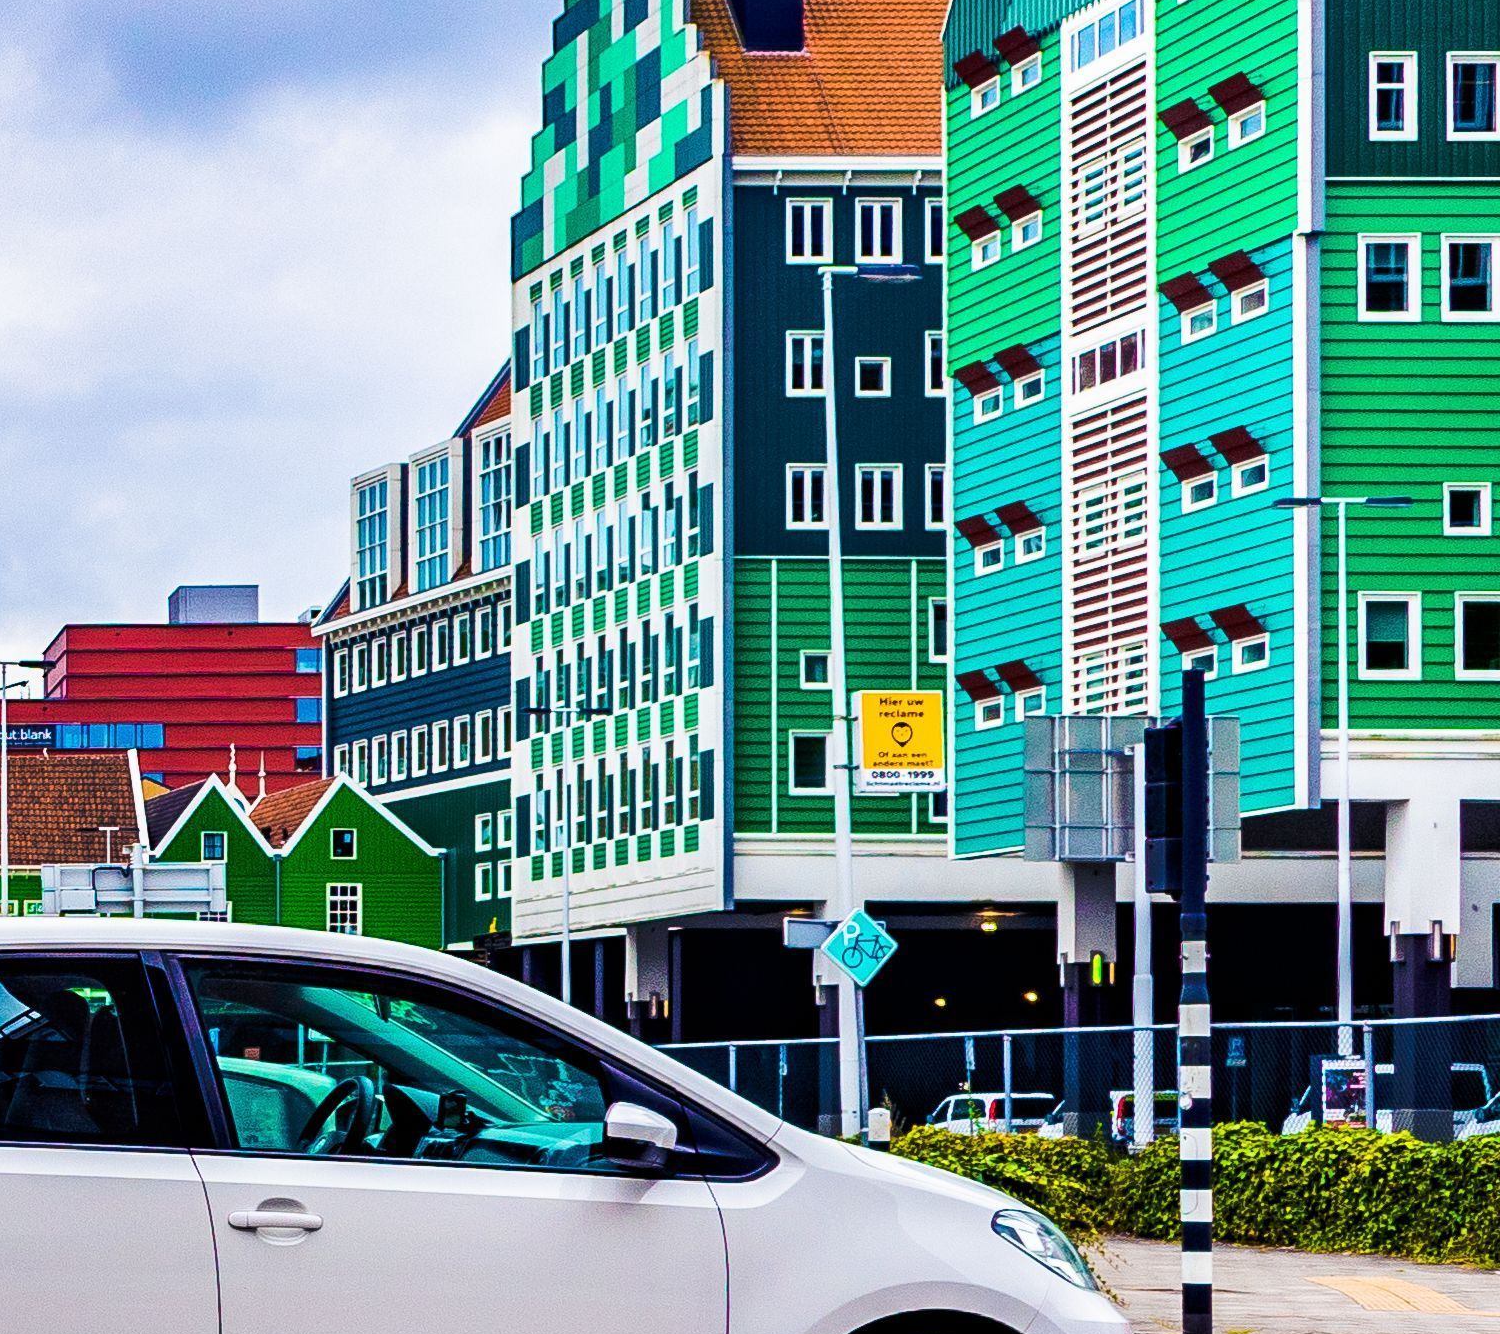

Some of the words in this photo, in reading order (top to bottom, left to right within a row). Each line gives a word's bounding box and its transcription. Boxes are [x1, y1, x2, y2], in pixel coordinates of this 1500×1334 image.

[879, 697, 903, 706] Hier
[879, 710, 924, 718] reclame
[842, 920, 861, 946] P
